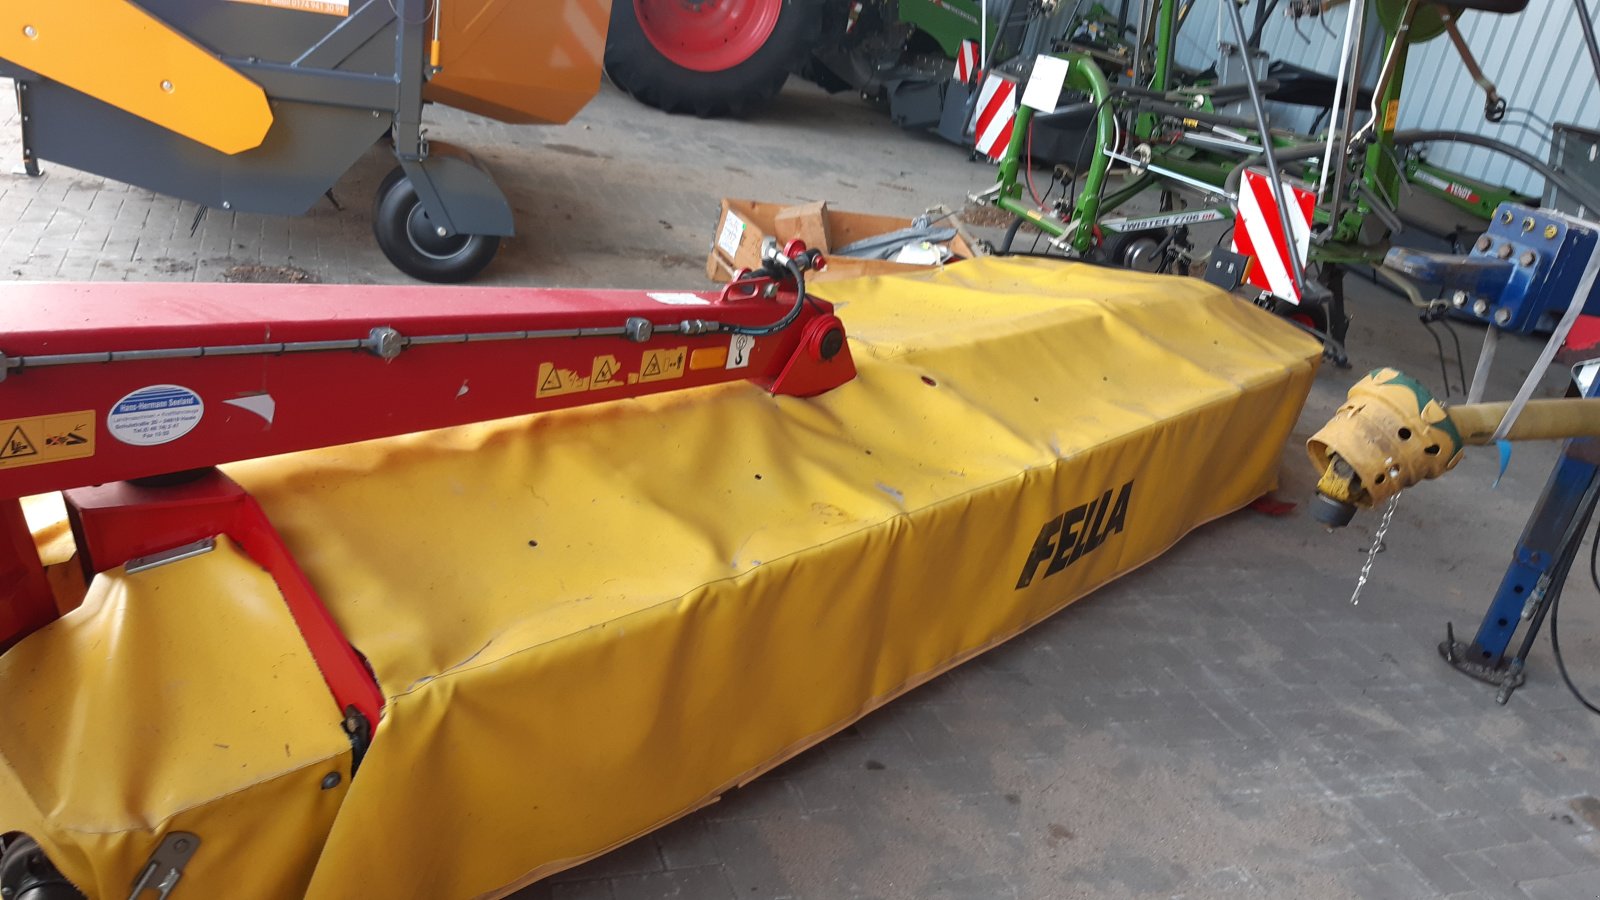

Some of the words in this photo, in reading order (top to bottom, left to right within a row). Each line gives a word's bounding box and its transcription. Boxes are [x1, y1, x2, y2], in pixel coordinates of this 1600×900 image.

[1450, 182, 1473, 200] FENDT
[1120, 218, 1169, 231] TWISTER
[1173, 214, 1200, 224] 7706
[120, 400, 167, 412] Hans-Hermann
[168, 397, 194, 407] Seeland
[1014, 479, 1134, 590] FELLA
